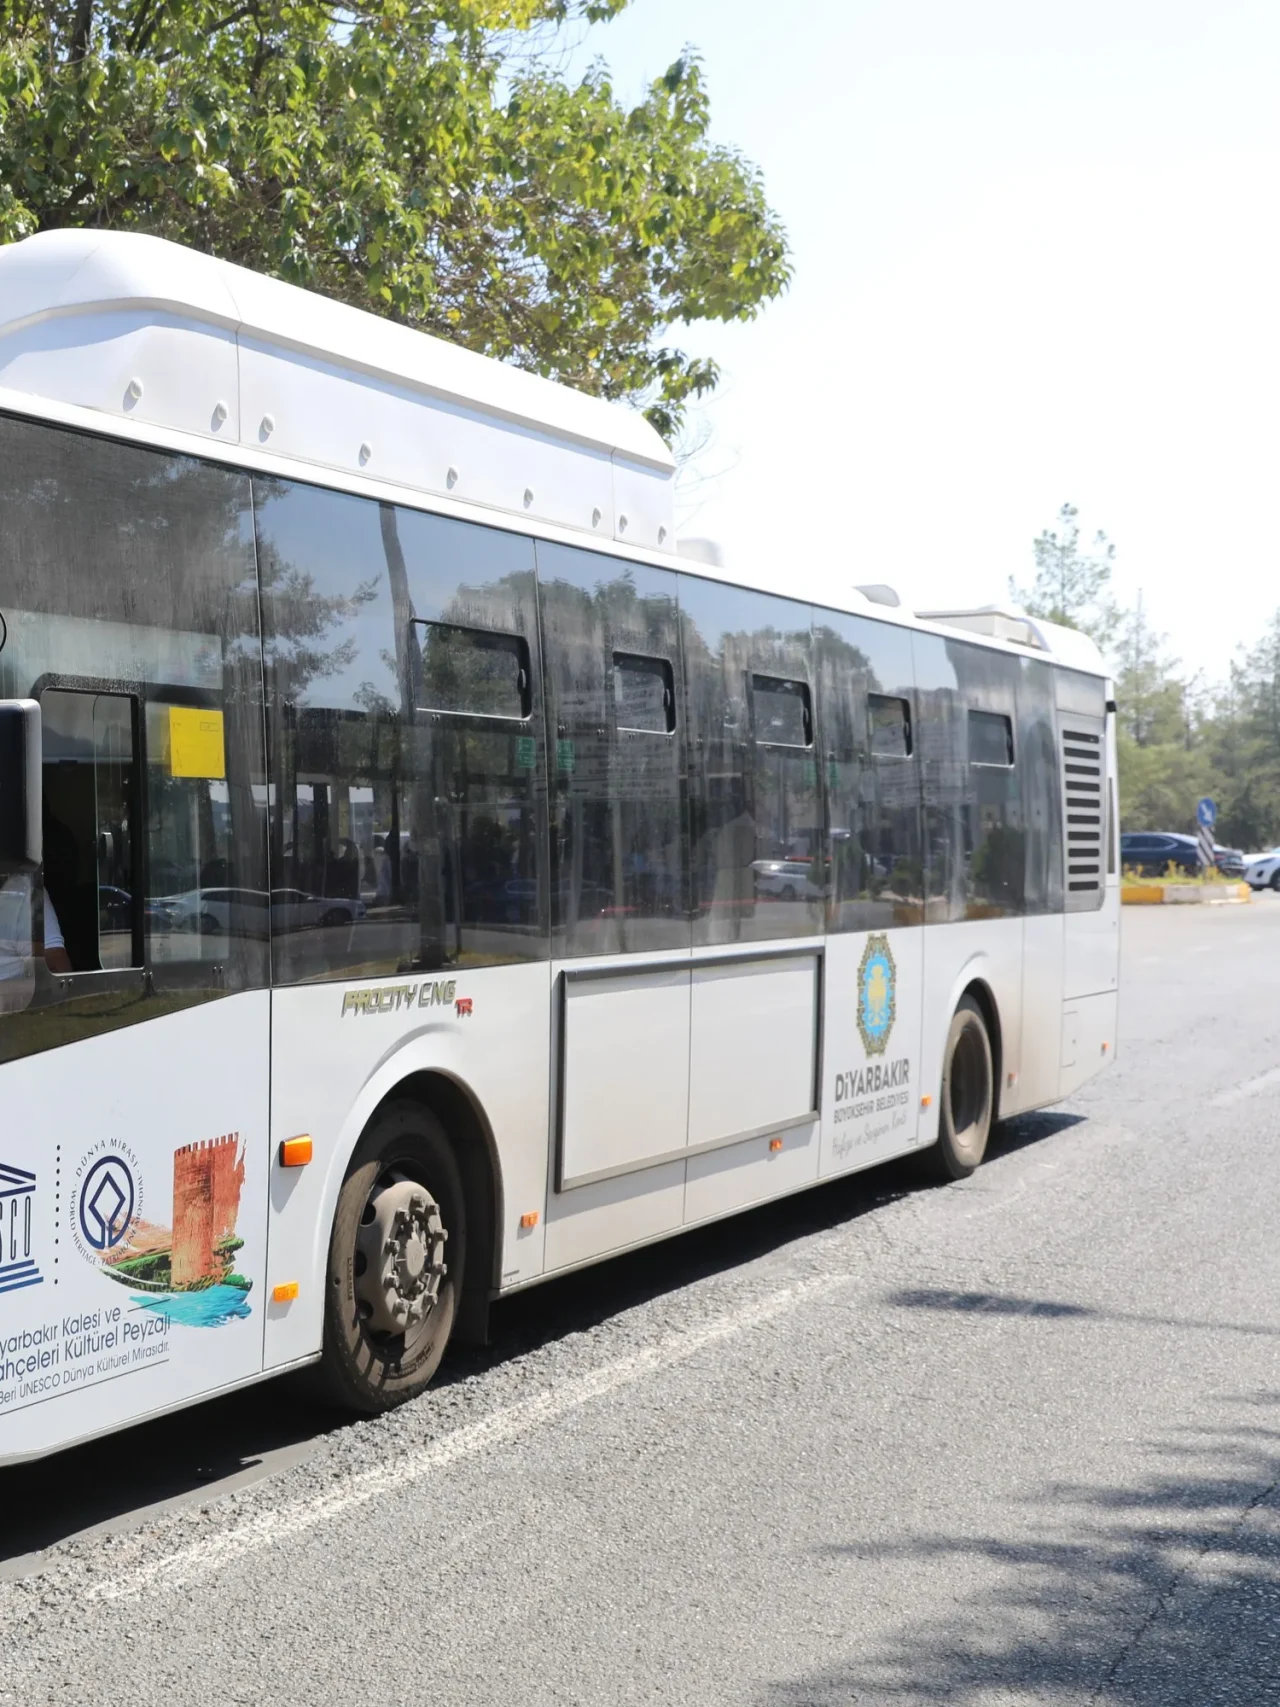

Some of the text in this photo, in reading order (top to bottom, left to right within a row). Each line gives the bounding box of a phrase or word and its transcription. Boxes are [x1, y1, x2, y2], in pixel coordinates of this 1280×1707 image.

[341, 980, 456, 1018] PROCITY CNG
[75, 1139, 106, 1178] DÜNYA
[68, 1189, 97, 1266] WORLD HERITAGE
[62, 1307, 101, 1338] Kalesi
[104, 1306, 121, 1325] ve
[64, 1325, 118, 1362] Kültürel
[122, 1311, 171, 1344] Peyzajı
[19, 1373, 61, 1399] UNESCO
[62, 1364, 95, 1385] Dünya
[95, 1351, 130, 1374] Kültürel
